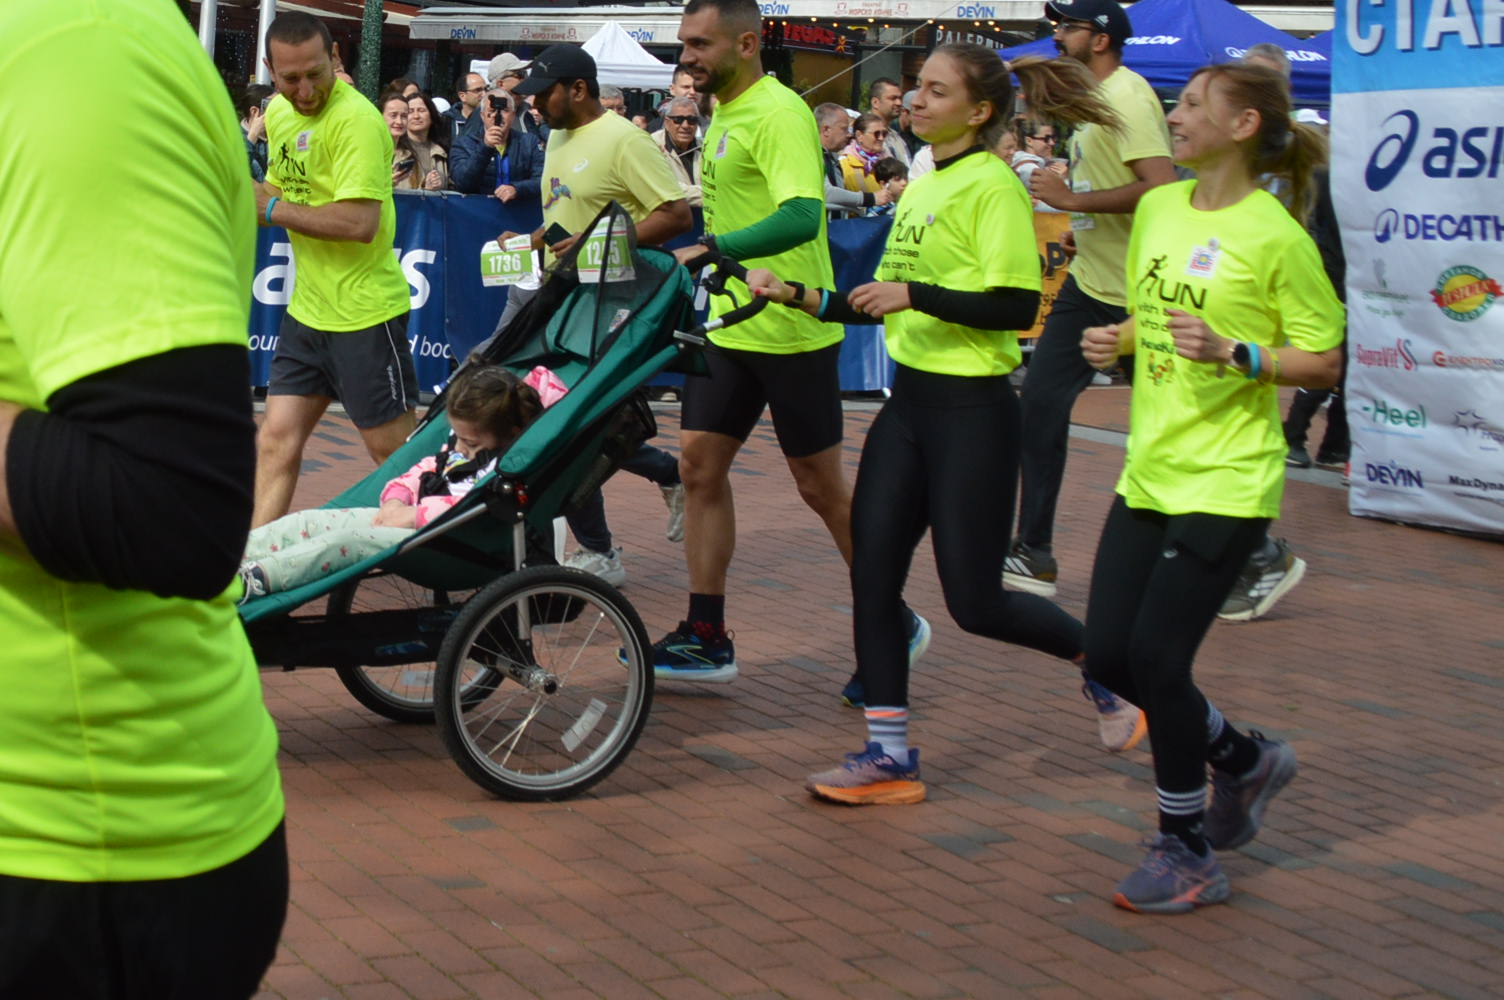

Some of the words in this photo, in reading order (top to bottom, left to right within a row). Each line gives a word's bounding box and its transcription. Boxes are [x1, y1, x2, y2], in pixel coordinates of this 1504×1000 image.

[957, 2, 995, 18] DEVIN
[450, 26, 477, 39] DEVIN
[1422, 127, 1504, 178] asi
[1403, 213, 1504, 241] DECATH
[488, 253, 522, 274] 1736
[1365, 462, 1425, 489] DEVIN
